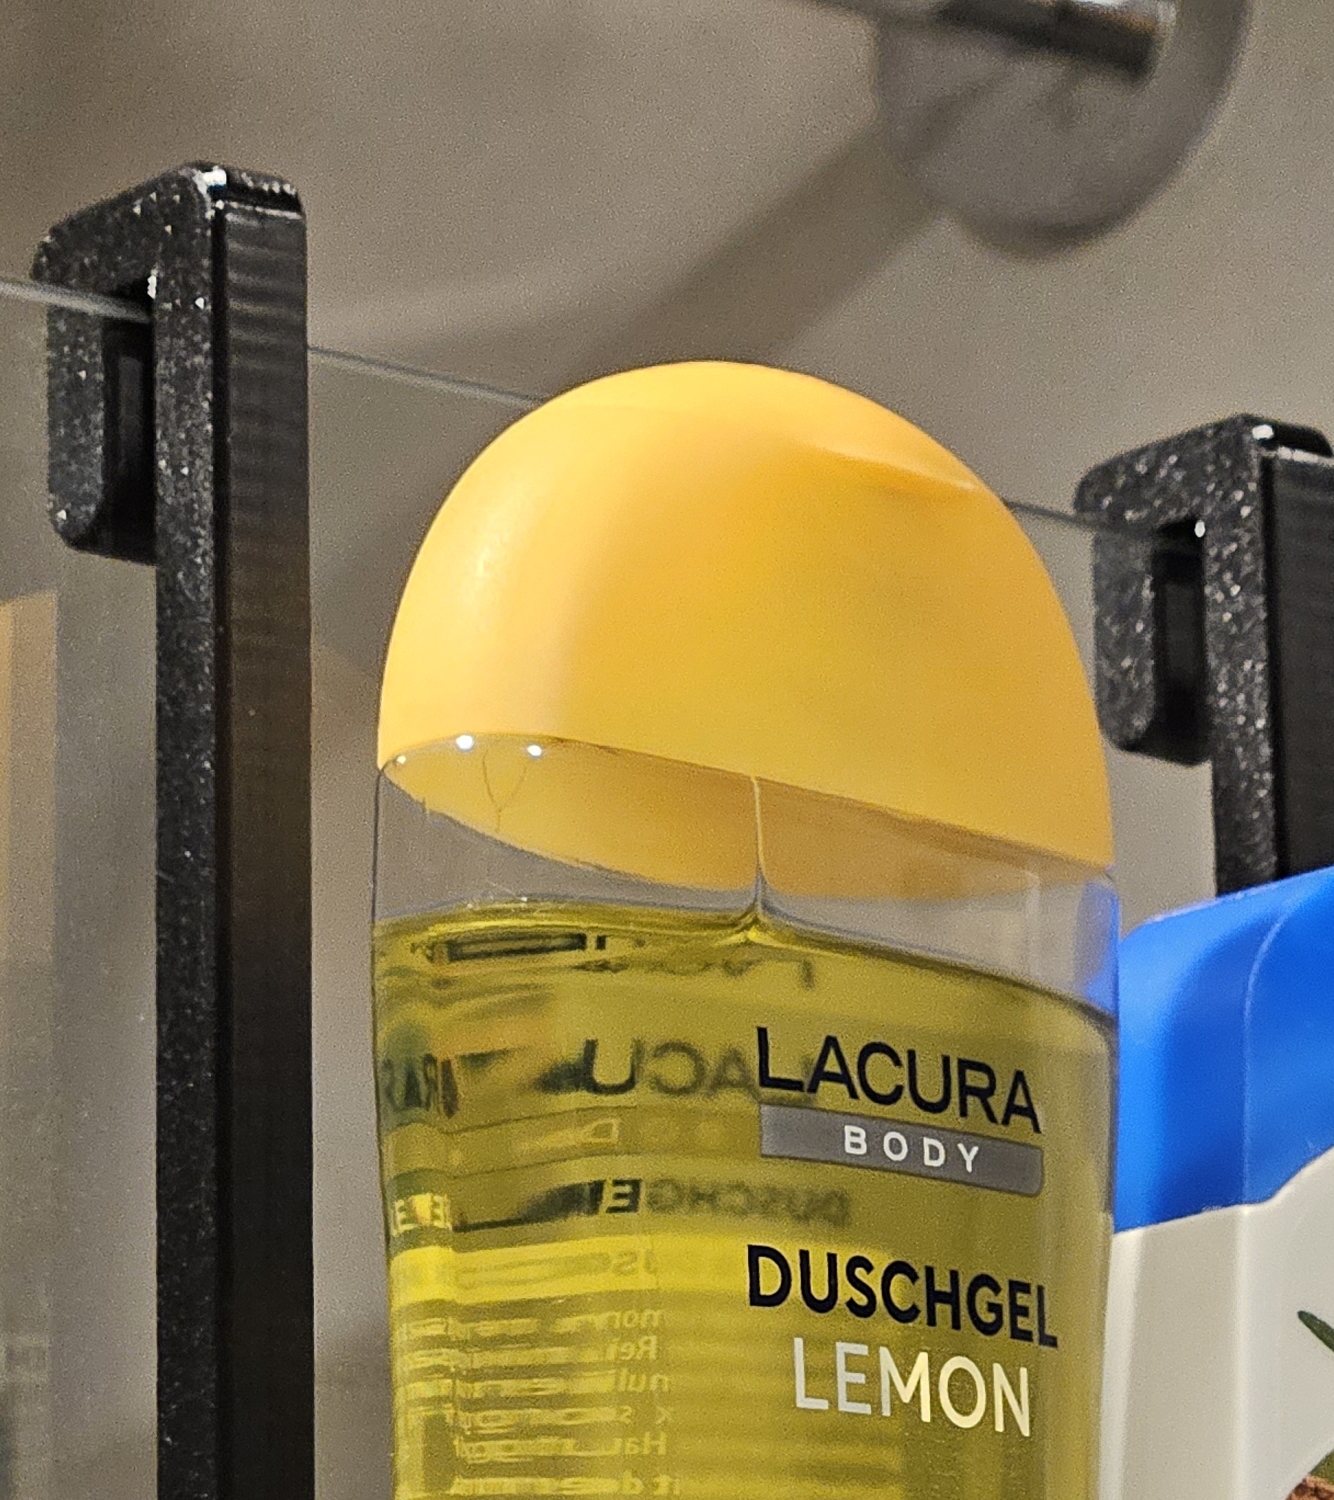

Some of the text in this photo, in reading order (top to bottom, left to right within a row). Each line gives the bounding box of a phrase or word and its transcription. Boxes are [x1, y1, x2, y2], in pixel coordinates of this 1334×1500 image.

[756, 1026, 1043, 1134] LACURA
[843, 1124, 981, 1173] BODY
[746, 1243, 1059, 1349] DUSCHGEL
[792, 1336, 1031, 1437] LEMON
